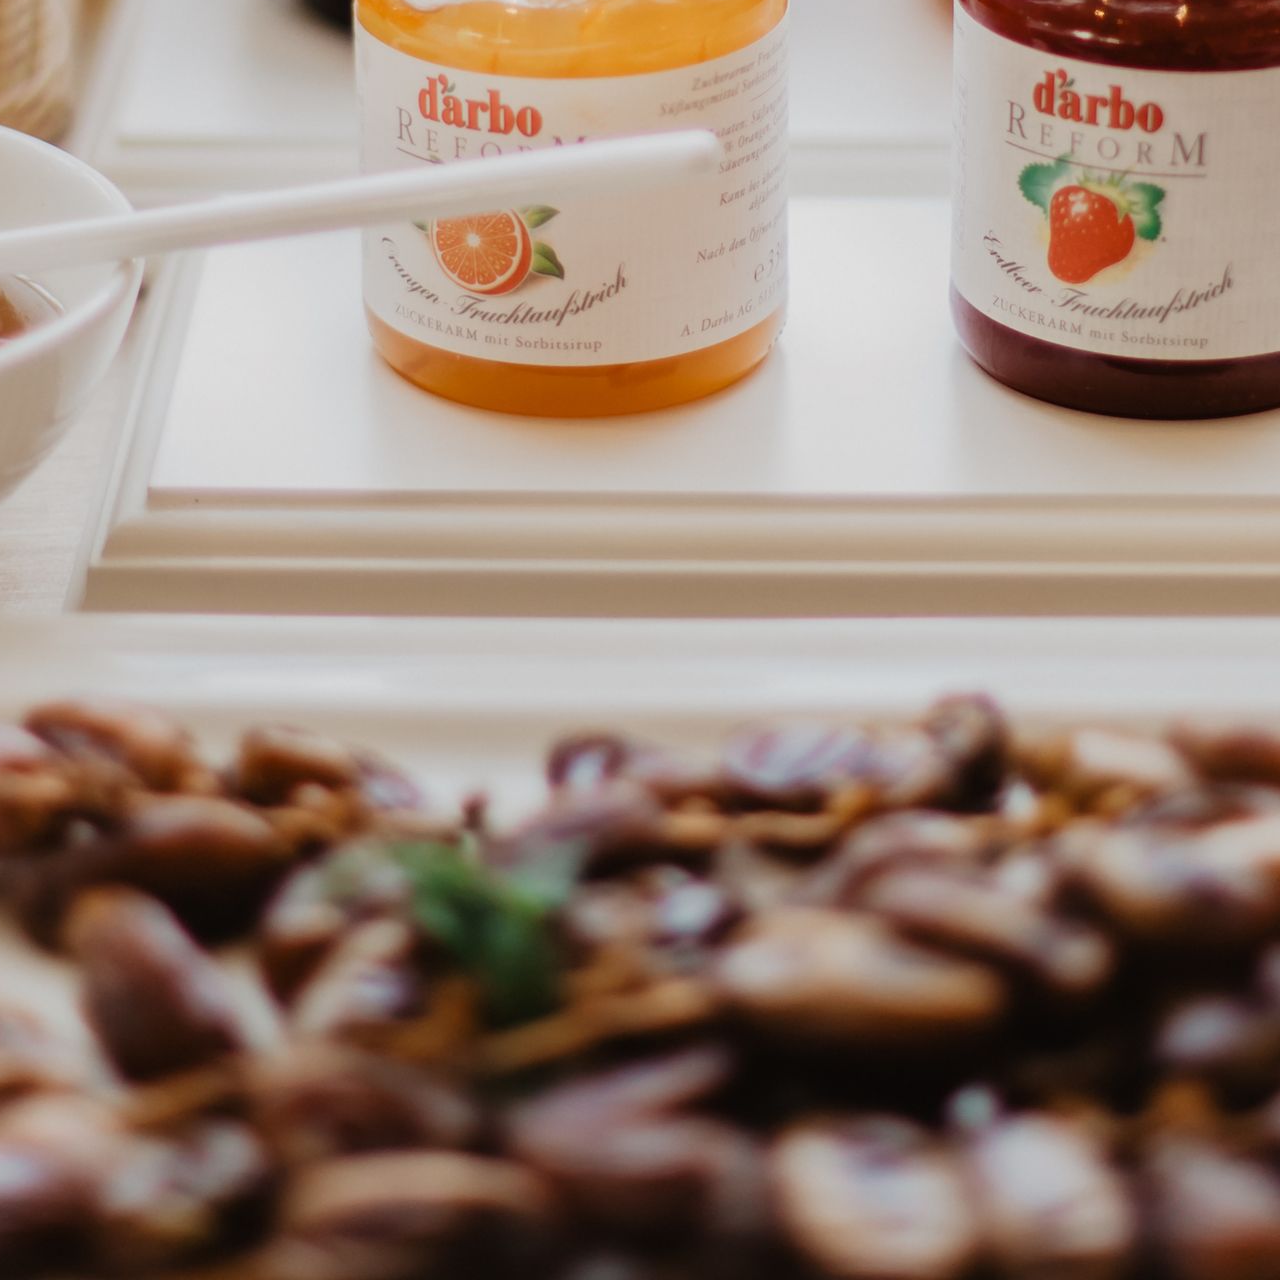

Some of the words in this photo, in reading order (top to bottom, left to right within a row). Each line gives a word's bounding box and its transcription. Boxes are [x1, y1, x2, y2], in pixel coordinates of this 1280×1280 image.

[1006, 99, 1209, 168] REFORM
[484, 332, 510, 348] mit
[515, 334, 603, 353] Sorbitsirup
[992, 294, 1083, 337] ZUCKERARM
[1089, 326, 1116, 342] mit
[1121, 330, 1209, 349] Sorbitsirup
